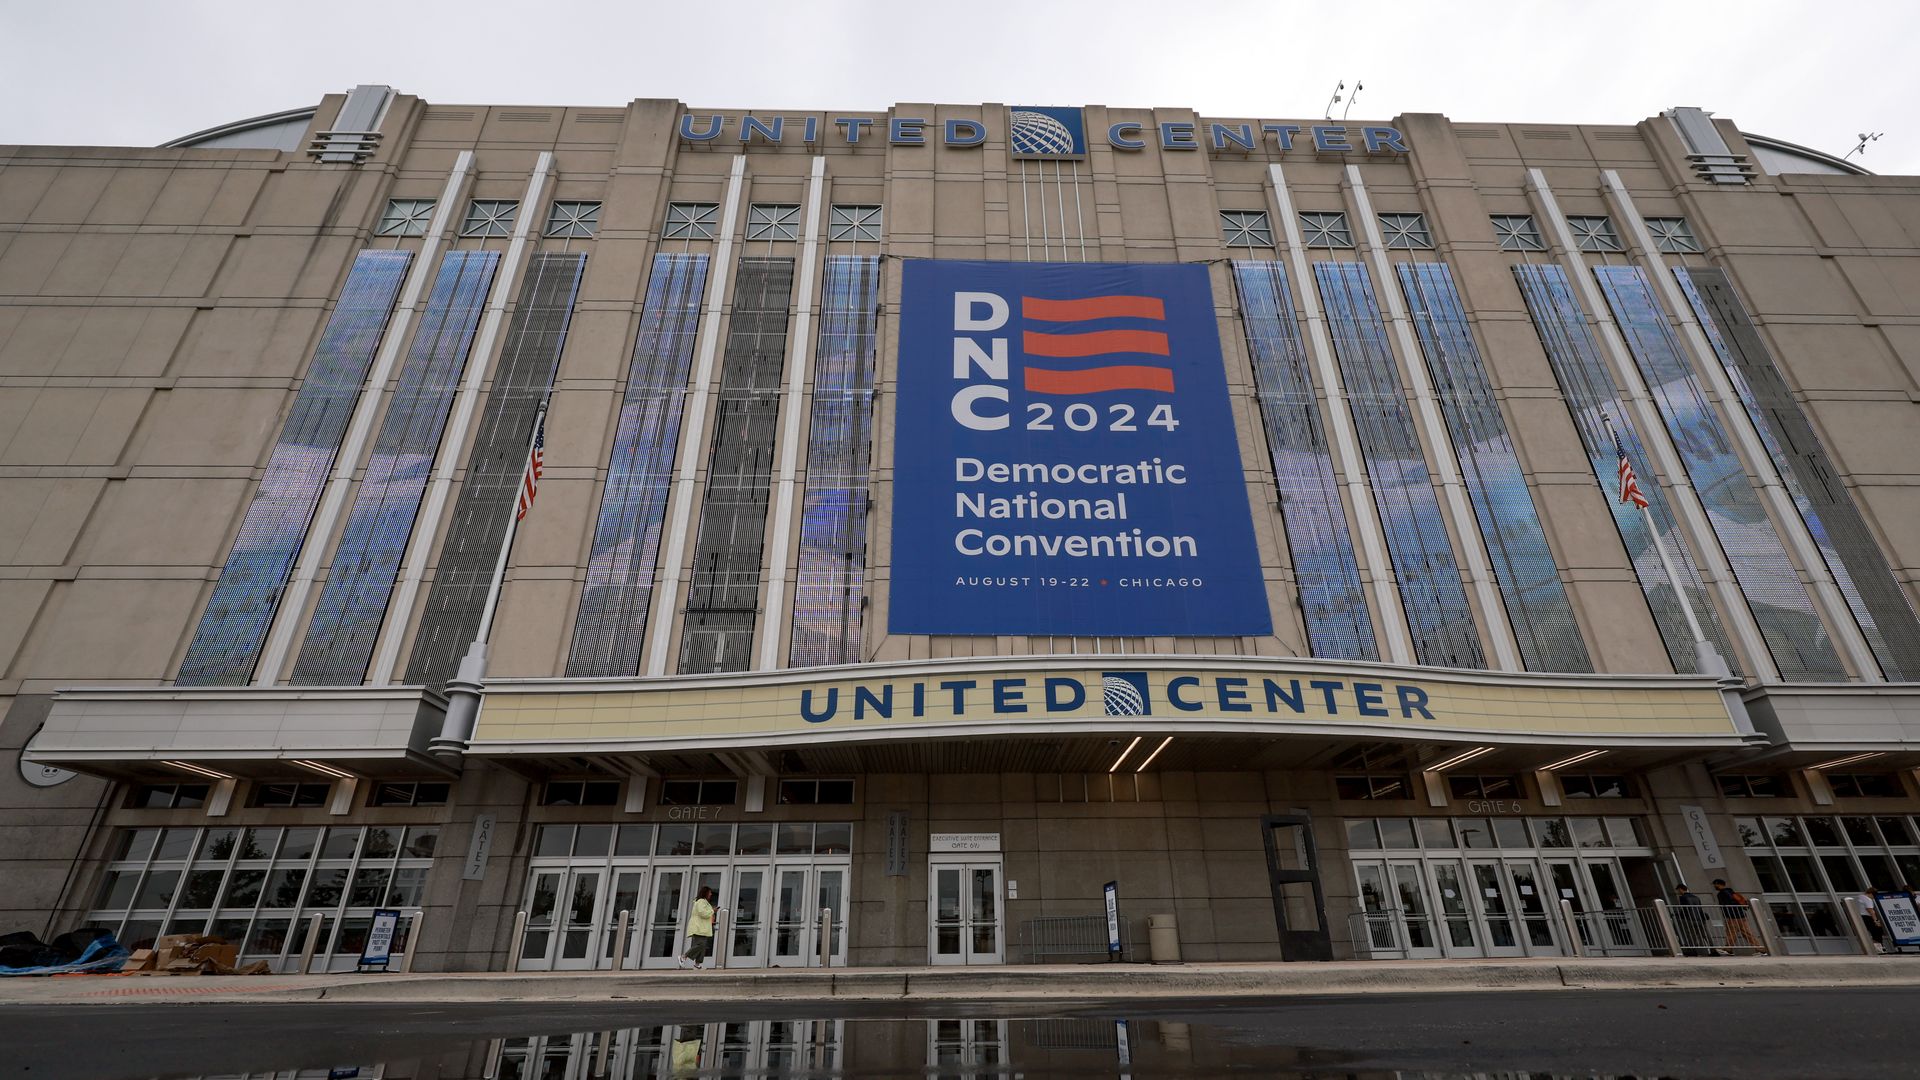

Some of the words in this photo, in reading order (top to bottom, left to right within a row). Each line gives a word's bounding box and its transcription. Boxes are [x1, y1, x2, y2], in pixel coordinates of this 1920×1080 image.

[679, 113, 987, 147] UNITED
[1107, 121, 1410, 153] CENTER
[951, 291, 1010, 431] DNC
[1026, 403, 1180, 432] 2024
[956, 457, 1187, 484] Democratic
[956, 490, 1128, 520] National
[955, 528, 1198, 558] Convention
[956, 576, 1031, 587] AUGUST
[1040, 577, 1090, 587] 19-22
[1119, 578, 1203, 588] CHICAGO
[800, 677, 1087, 723] UNITED
[1167, 676, 1437, 720] CENTER
[668, 806, 707, 820] GATE
[715, 806, 722, 819] 7
[1468, 800, 1506, 813] GATE
[1512, 801, 1521, 813] 6
[476, 820, 490, 862] GATE
[1690, 810, 1710, 851] GATE
[1708, 853, 1716, 864] 6
[472, 865, 480, 875] 7
